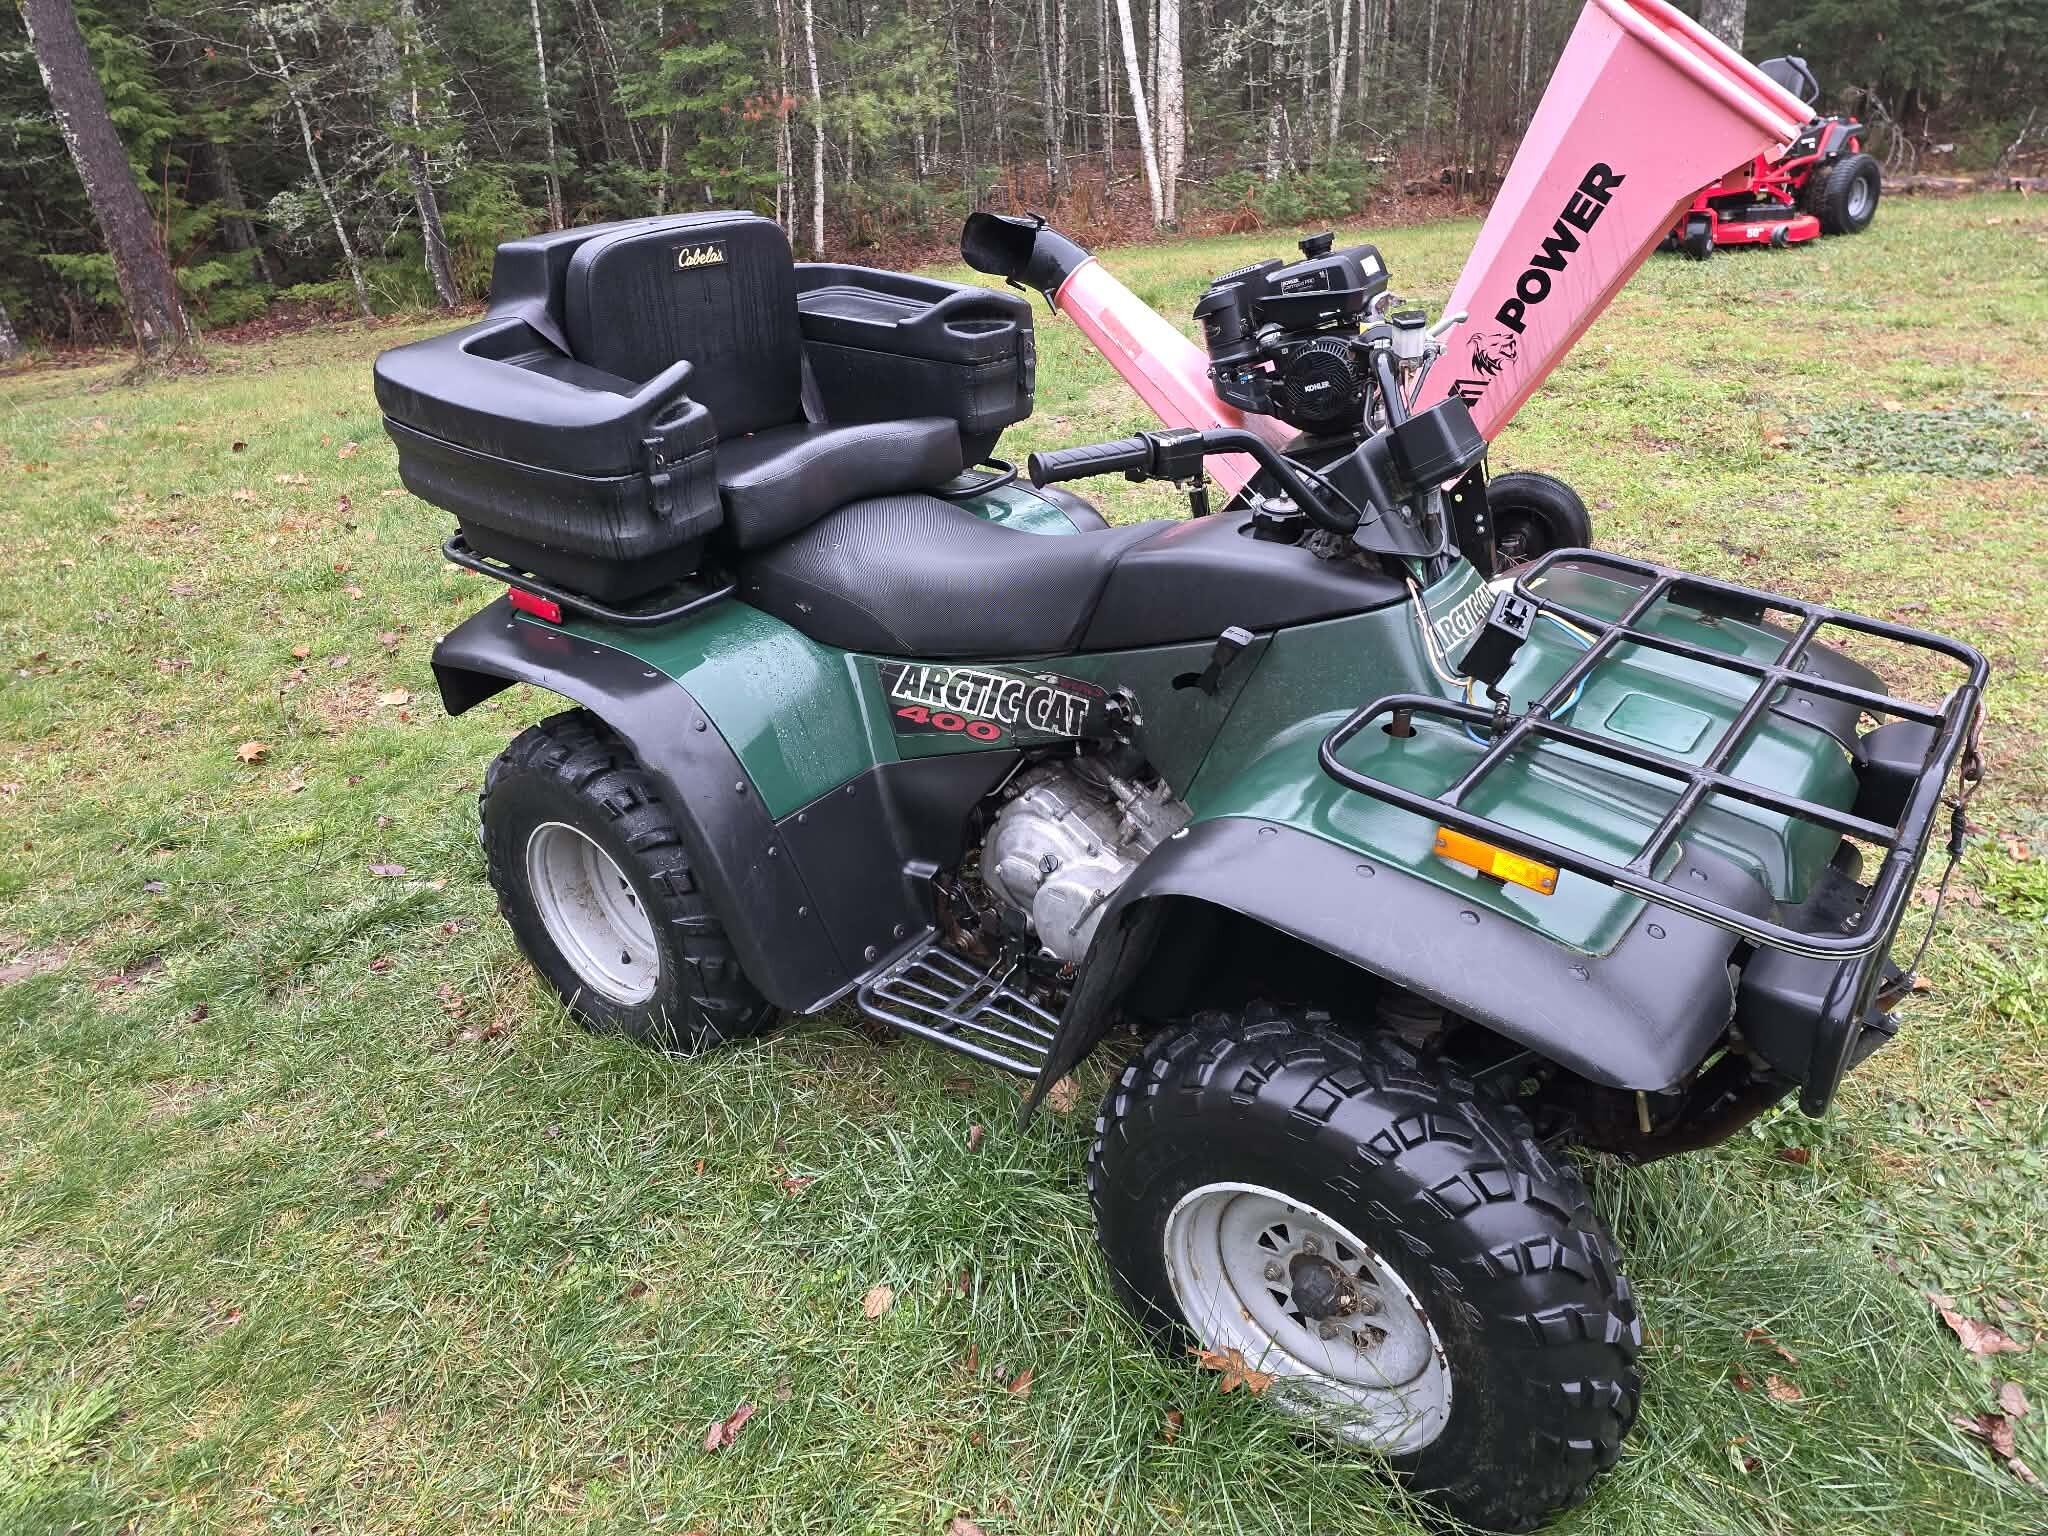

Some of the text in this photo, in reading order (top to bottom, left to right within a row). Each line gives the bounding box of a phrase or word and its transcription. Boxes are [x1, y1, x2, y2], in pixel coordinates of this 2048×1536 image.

[1494, 162, 1627, 335] POWER
[1304, 380, 1332, 393] KOHLER
[892, 664, 1090, 738] ARCTIC CAT
[896, 704, 1002, 742] 400
